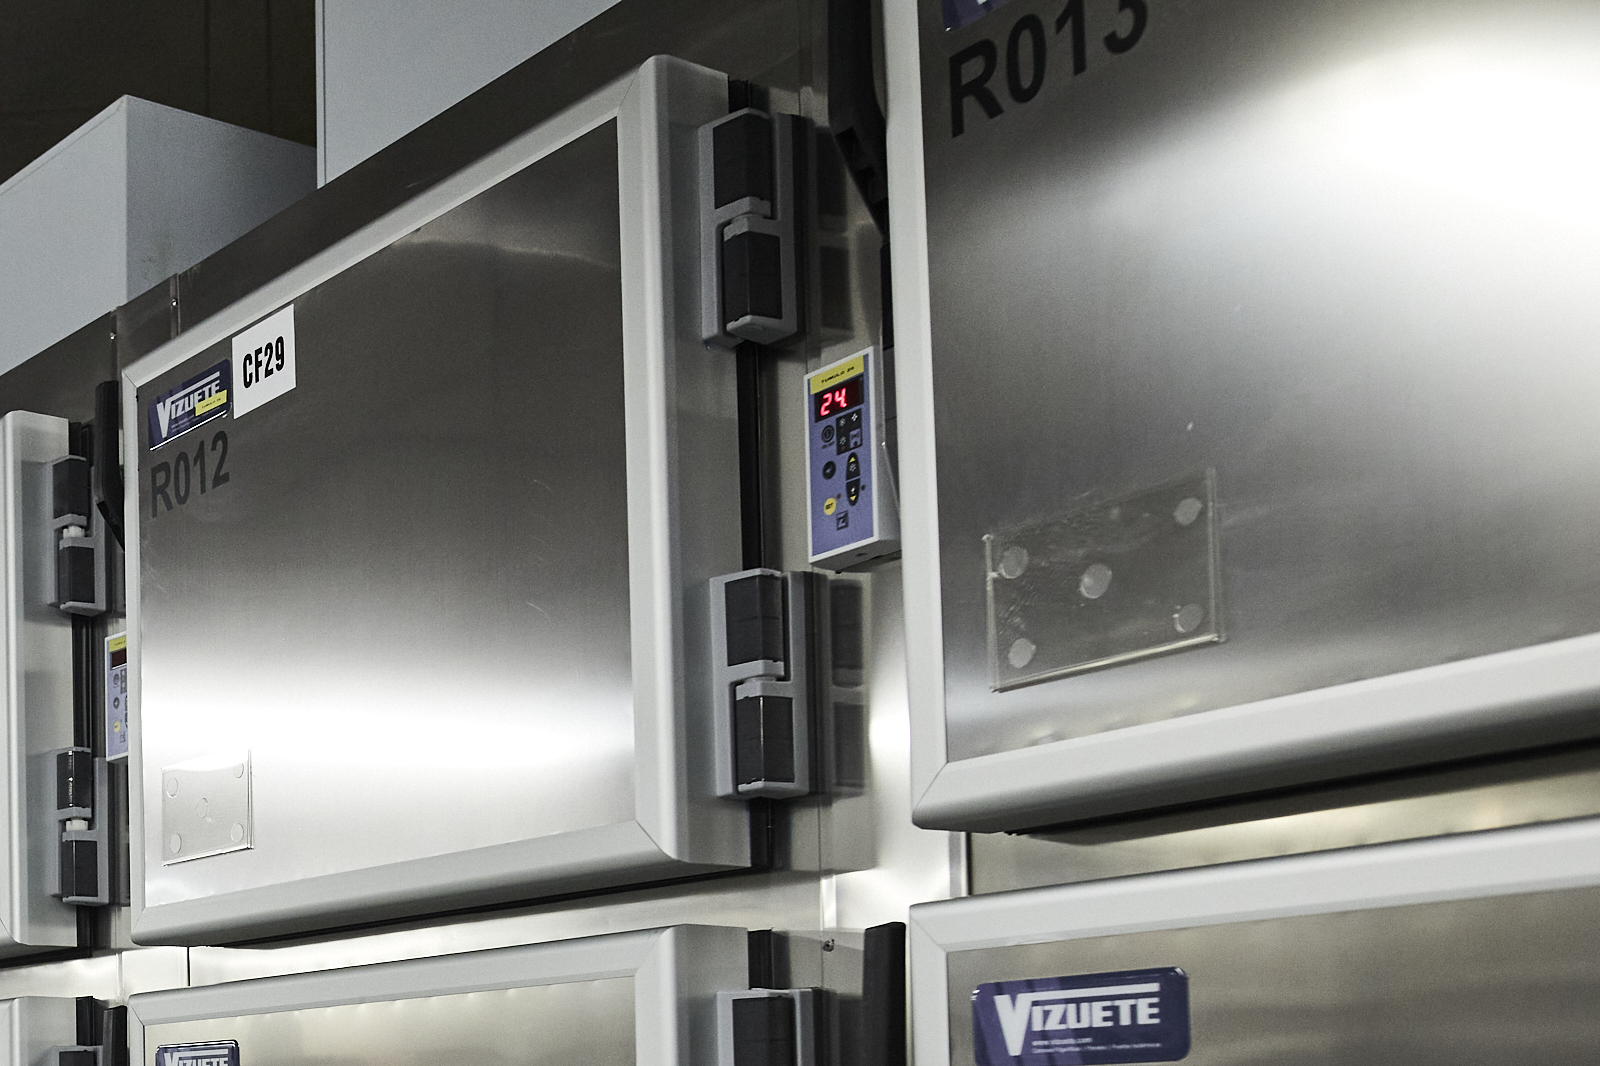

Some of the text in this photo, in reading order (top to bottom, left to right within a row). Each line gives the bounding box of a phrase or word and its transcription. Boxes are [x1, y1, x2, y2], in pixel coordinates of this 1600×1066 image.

[948, 0, 1148, 138] R013
[243, 336, 285, 388] CF29
[157, 371, 220, 438] VIZUETE
[151, 430, 230, 518] R012
[994, 982, 1160, 1057] VIZUETE
